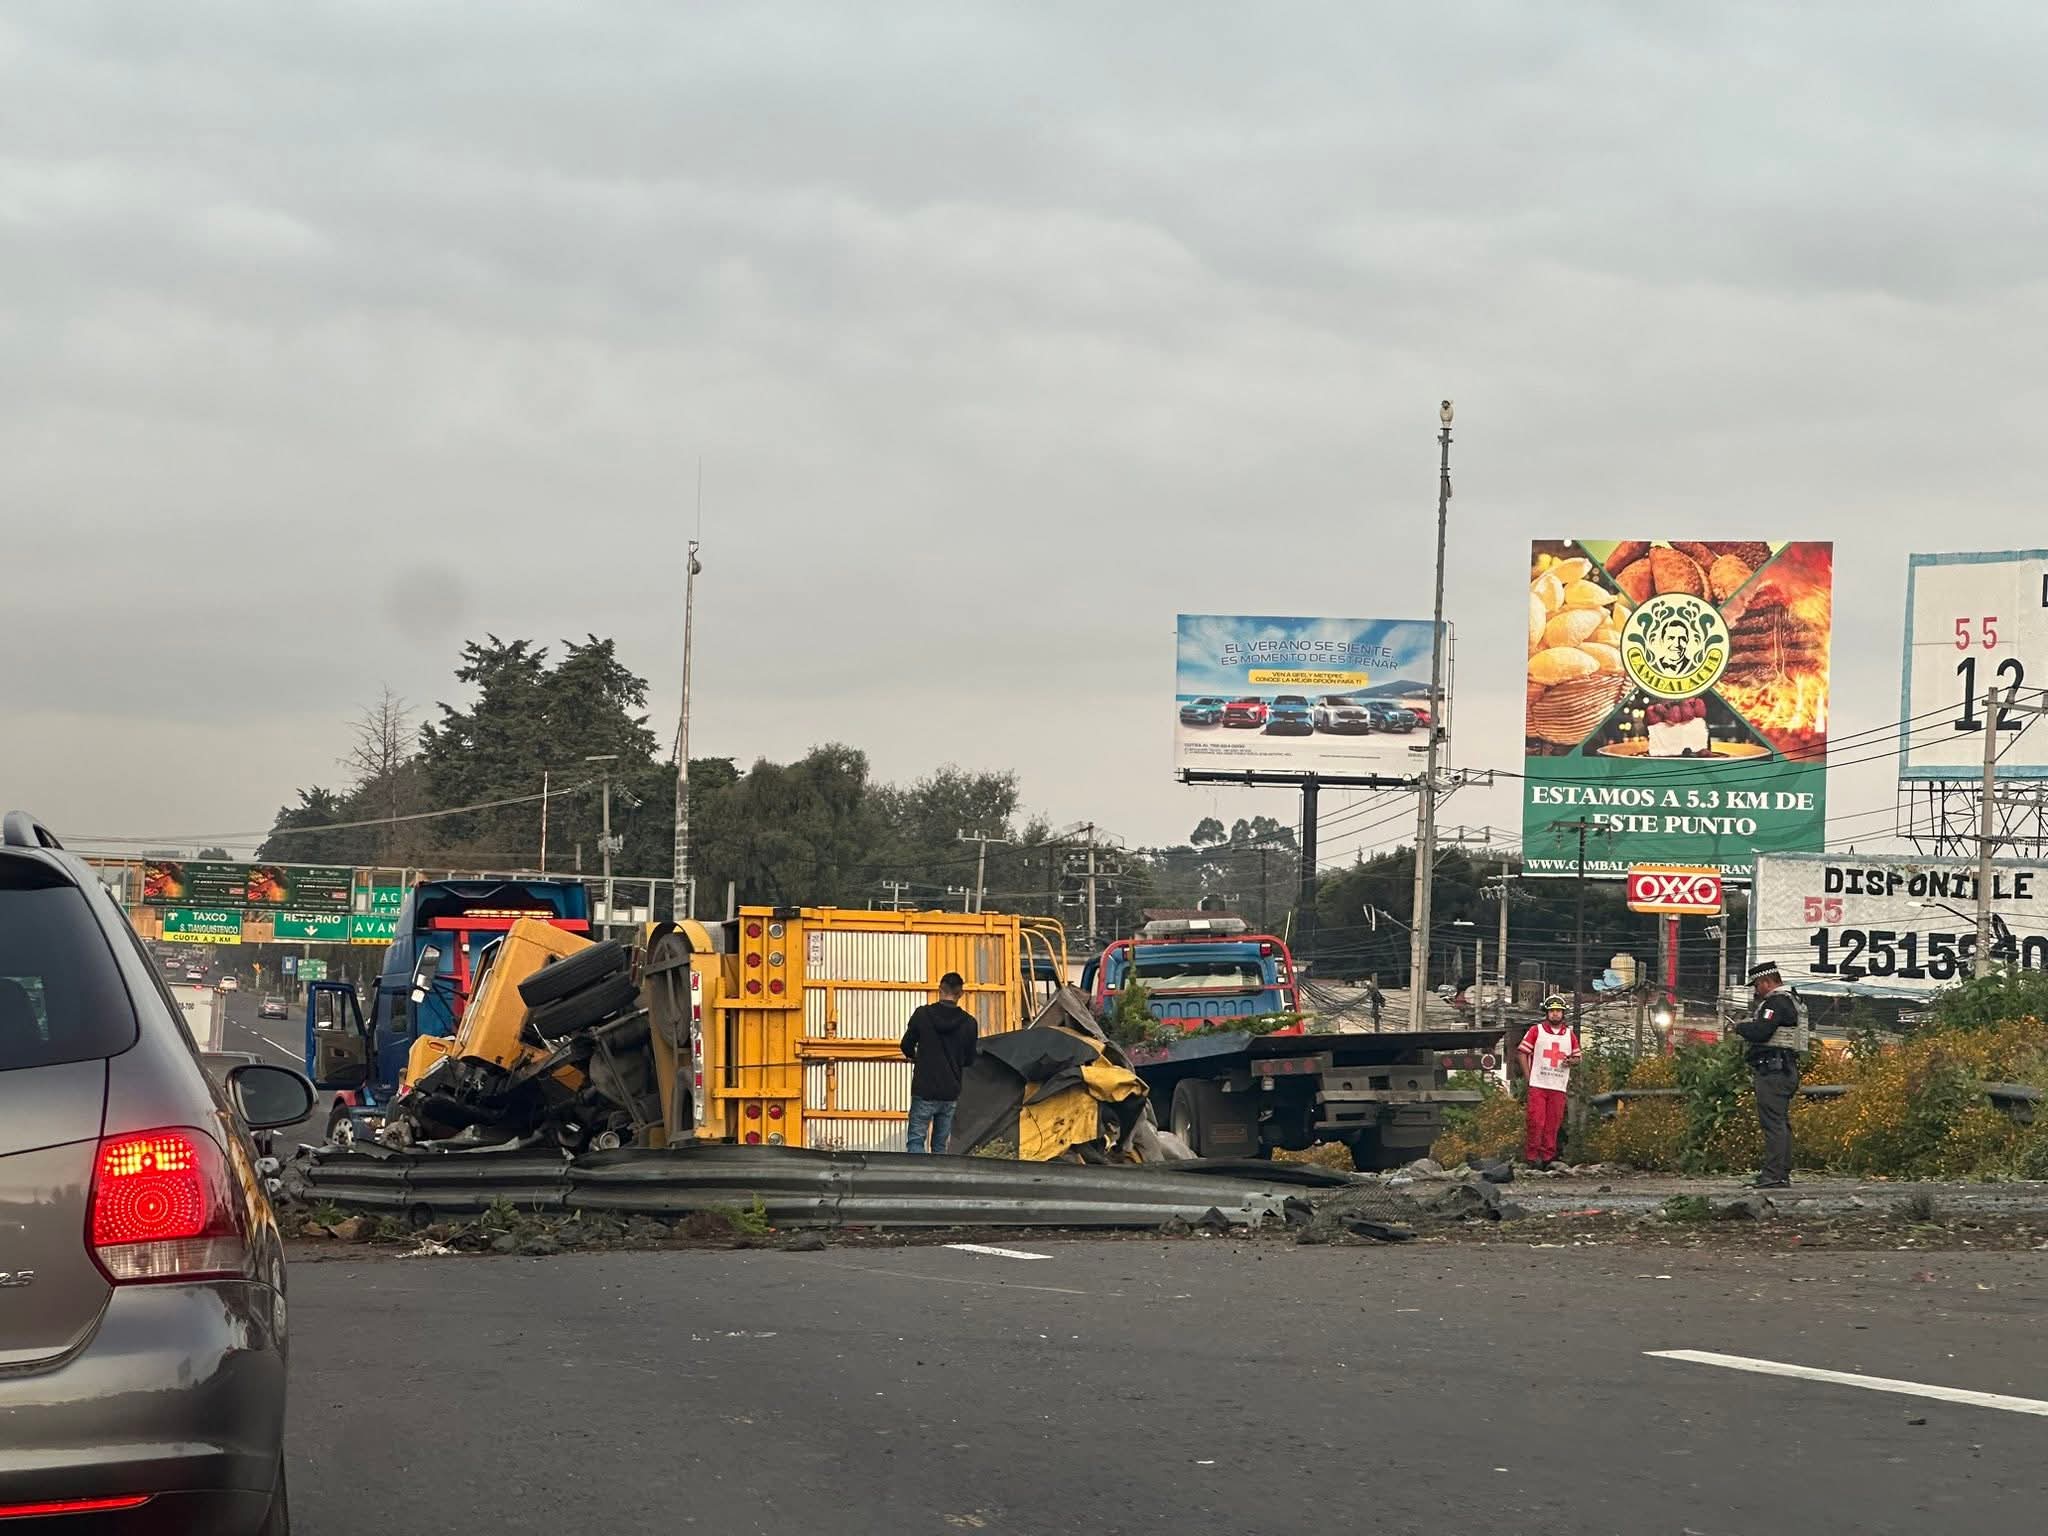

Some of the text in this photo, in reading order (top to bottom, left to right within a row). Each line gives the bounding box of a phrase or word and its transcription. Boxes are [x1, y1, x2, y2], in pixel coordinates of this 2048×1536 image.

[1224, 643, 1243, 654] EL
[1248, 641, 1311, 652] VERANO
[1314, 641, 1335, 652] SE
[1221, 653, 1399, 670] ES MOMENTO DE ESTRENAR
[1630, 651, 1719, 691] CAMBALACHE
[1531, 785, 1815, 811] ESTAMOS A 5.3 KM DE
[1592, 813, 1757, 836] ESTE PUNTO
[1635, 875, 1718, 904] OXXO
[192, 911, 227, 922] TAXCO
[283, 913, 341, 924] RETORNO
[1804, 896, 1843, 923] 55
[188, 923, 238, 935] TIANGUISTENCO
